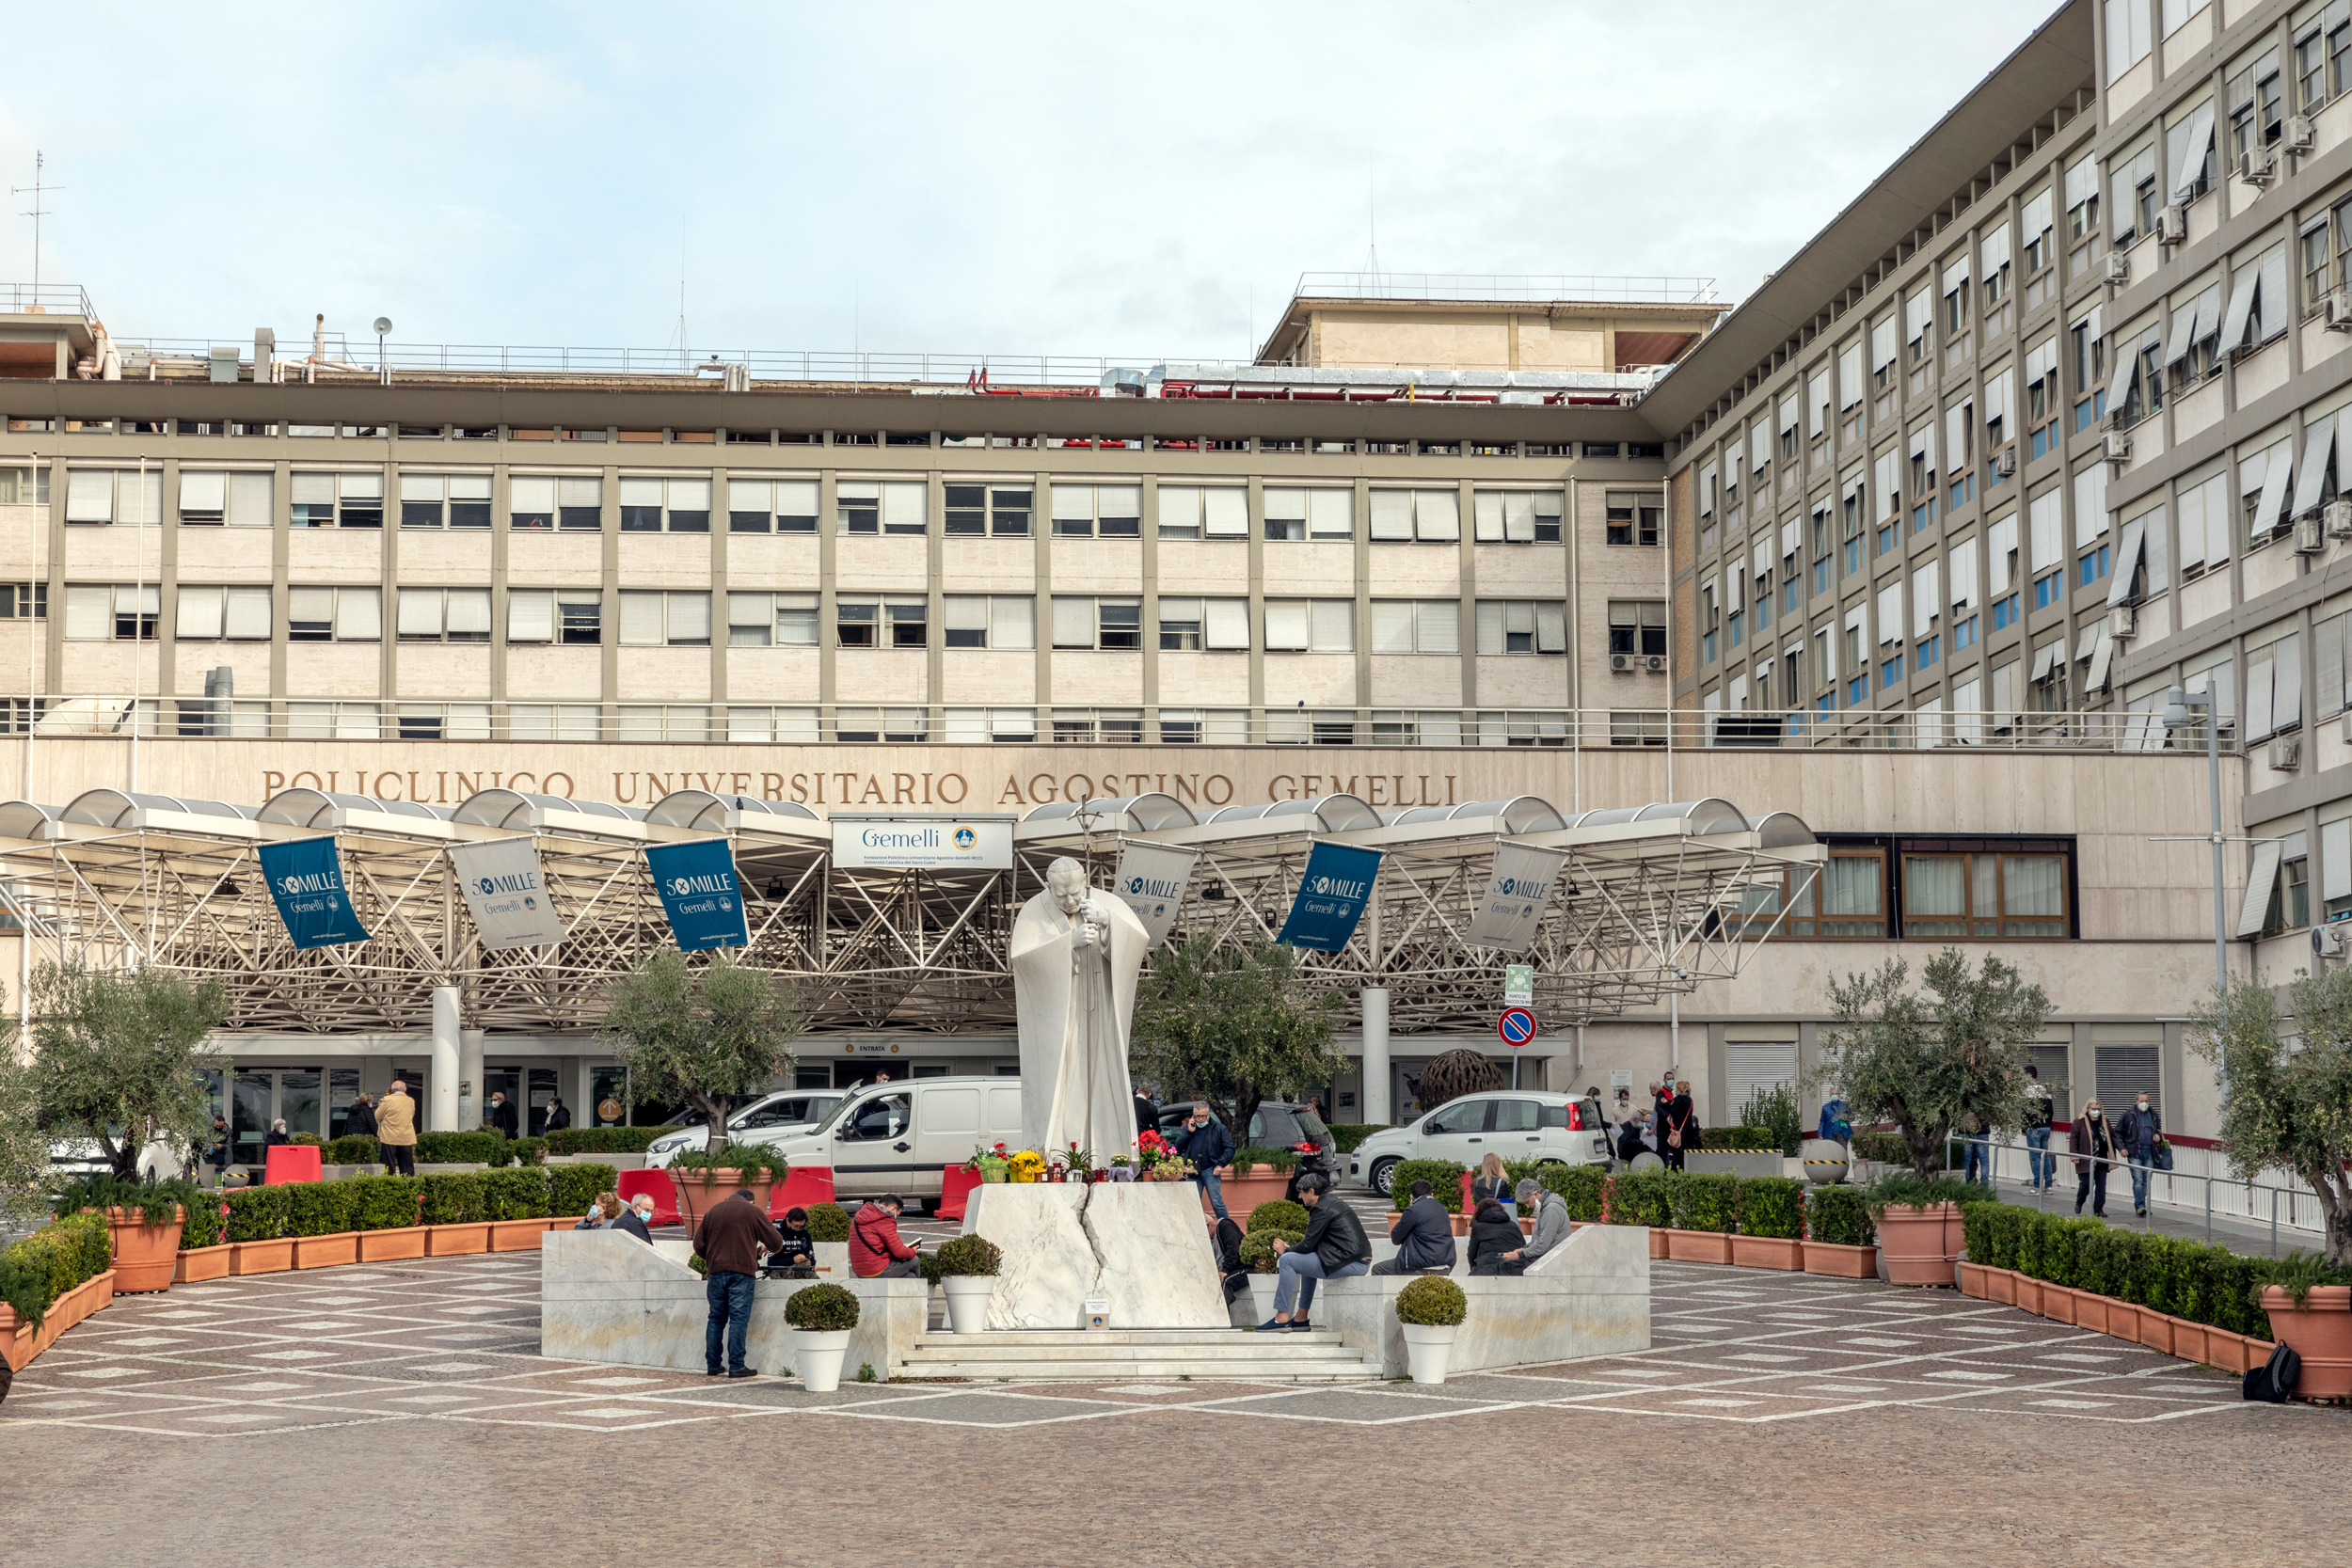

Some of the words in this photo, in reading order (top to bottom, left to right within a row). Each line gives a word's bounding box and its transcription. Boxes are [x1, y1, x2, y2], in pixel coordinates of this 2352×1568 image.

[262, 770, 574, 803] POLICLINICO
[612, 771, 969, 804] UNIVERSITARIO
[997, 772, 1233, 805] AGOSTINO
[1268, 774, 1456, 806] GEMELLI
[863, 828, 939, 847] Gemelli
[290, 899, 325, 913] Gemelli
[485, 900, 521, 914] Gemelli
[679, 899, 717, 914] Gemelli
[1305, 900, 1336, 914] Gemelli
[1490, 901, 1520, 915] Gemelli
